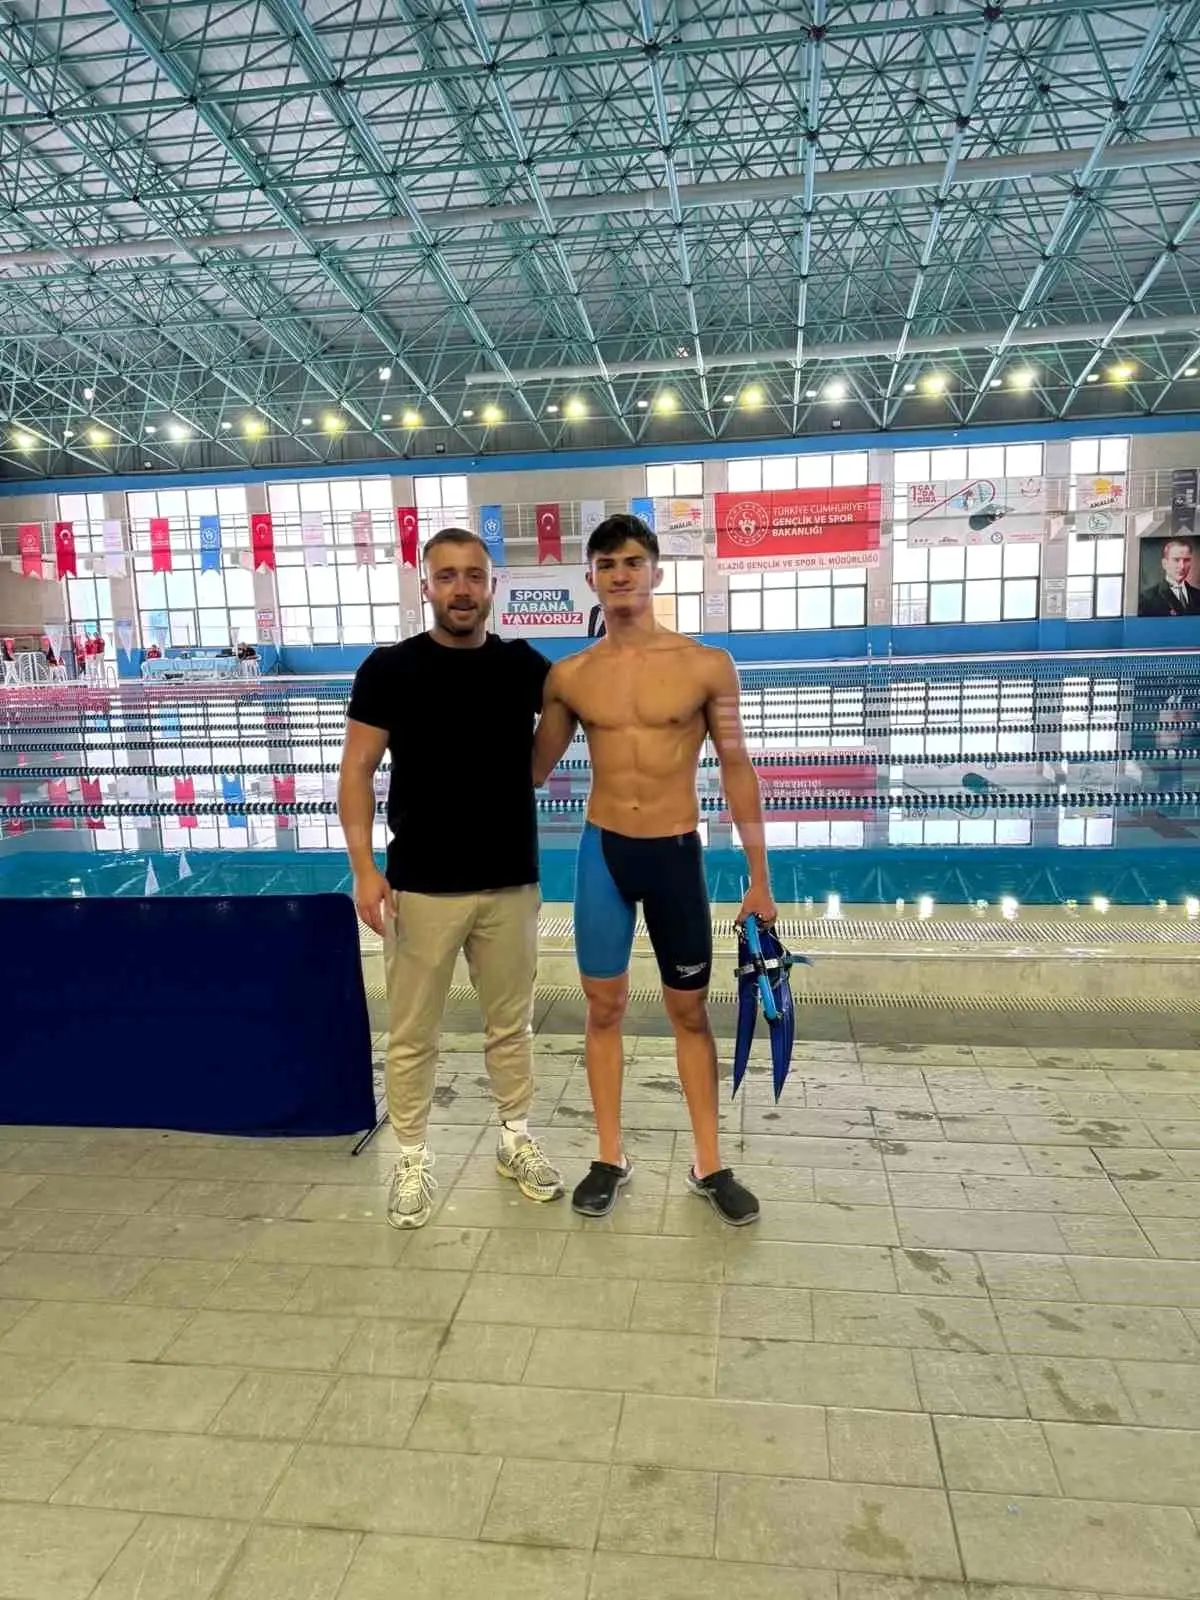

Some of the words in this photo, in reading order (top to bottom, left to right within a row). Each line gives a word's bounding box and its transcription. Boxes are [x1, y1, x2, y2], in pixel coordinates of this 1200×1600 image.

[772, 516, 812, 528] GENÇLİK
[814, 515, 827, 525] VE
[827, 513, 854, 524] SPOR
[772, 525, 823, 537] BAKANLIĞI
[747, 559, 780, 570] GENÇLİK
[783, 559, 793, 568] VE
[795, 557, 817, 567] SPOR
[515, 590, 562, 601] SPORU
[511, 601, 569, 612] TABANA
[504, 613, 582, 625] YAYIYORUZ
